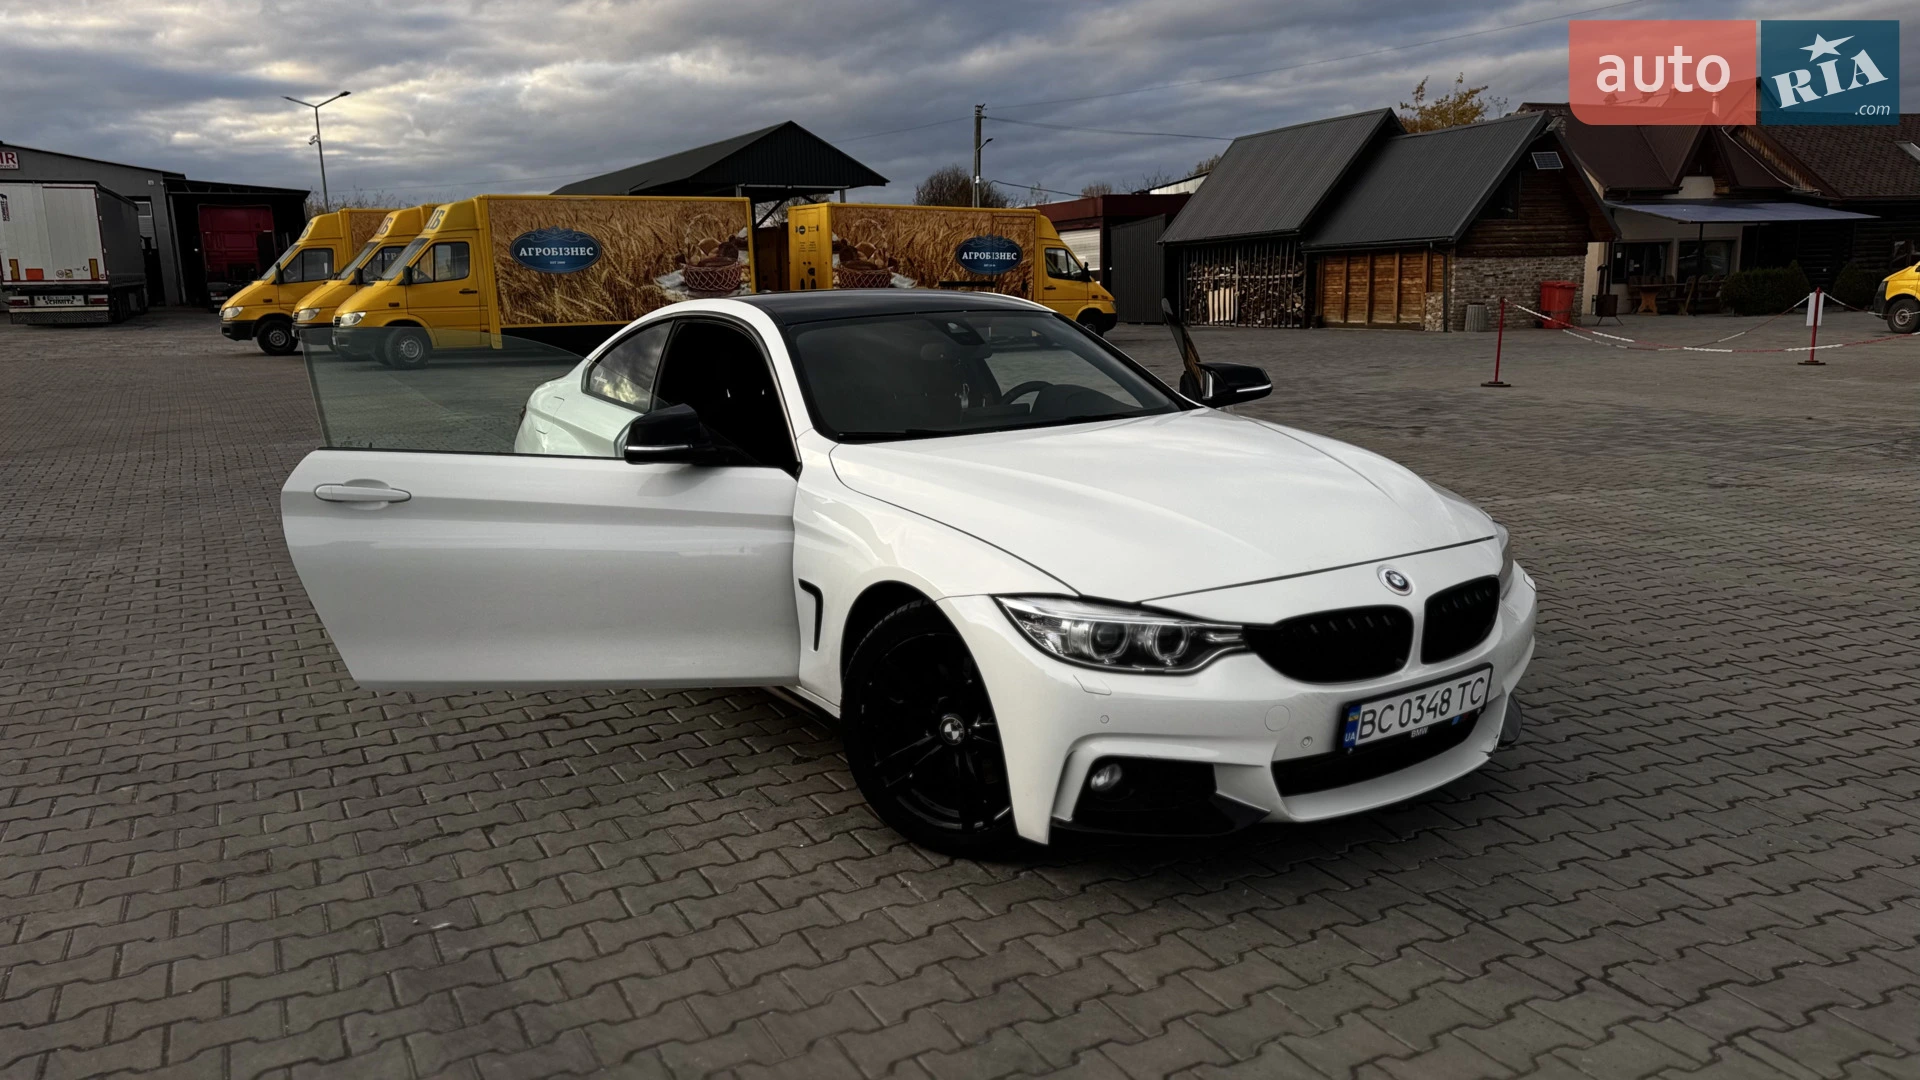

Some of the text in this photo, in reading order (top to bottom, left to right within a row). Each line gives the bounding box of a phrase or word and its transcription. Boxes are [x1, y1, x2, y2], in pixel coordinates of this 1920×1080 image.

[519, 247, 594, 257] АГРОБІЗНЕС
[962, 251, 1017, 260] АГРОБІЗНЕС
[1358, 677, 1485, 740] BC 0348 TC
[1345, 732, 1356, 742] UA
[1411, 727, 1428, 738] BMW
